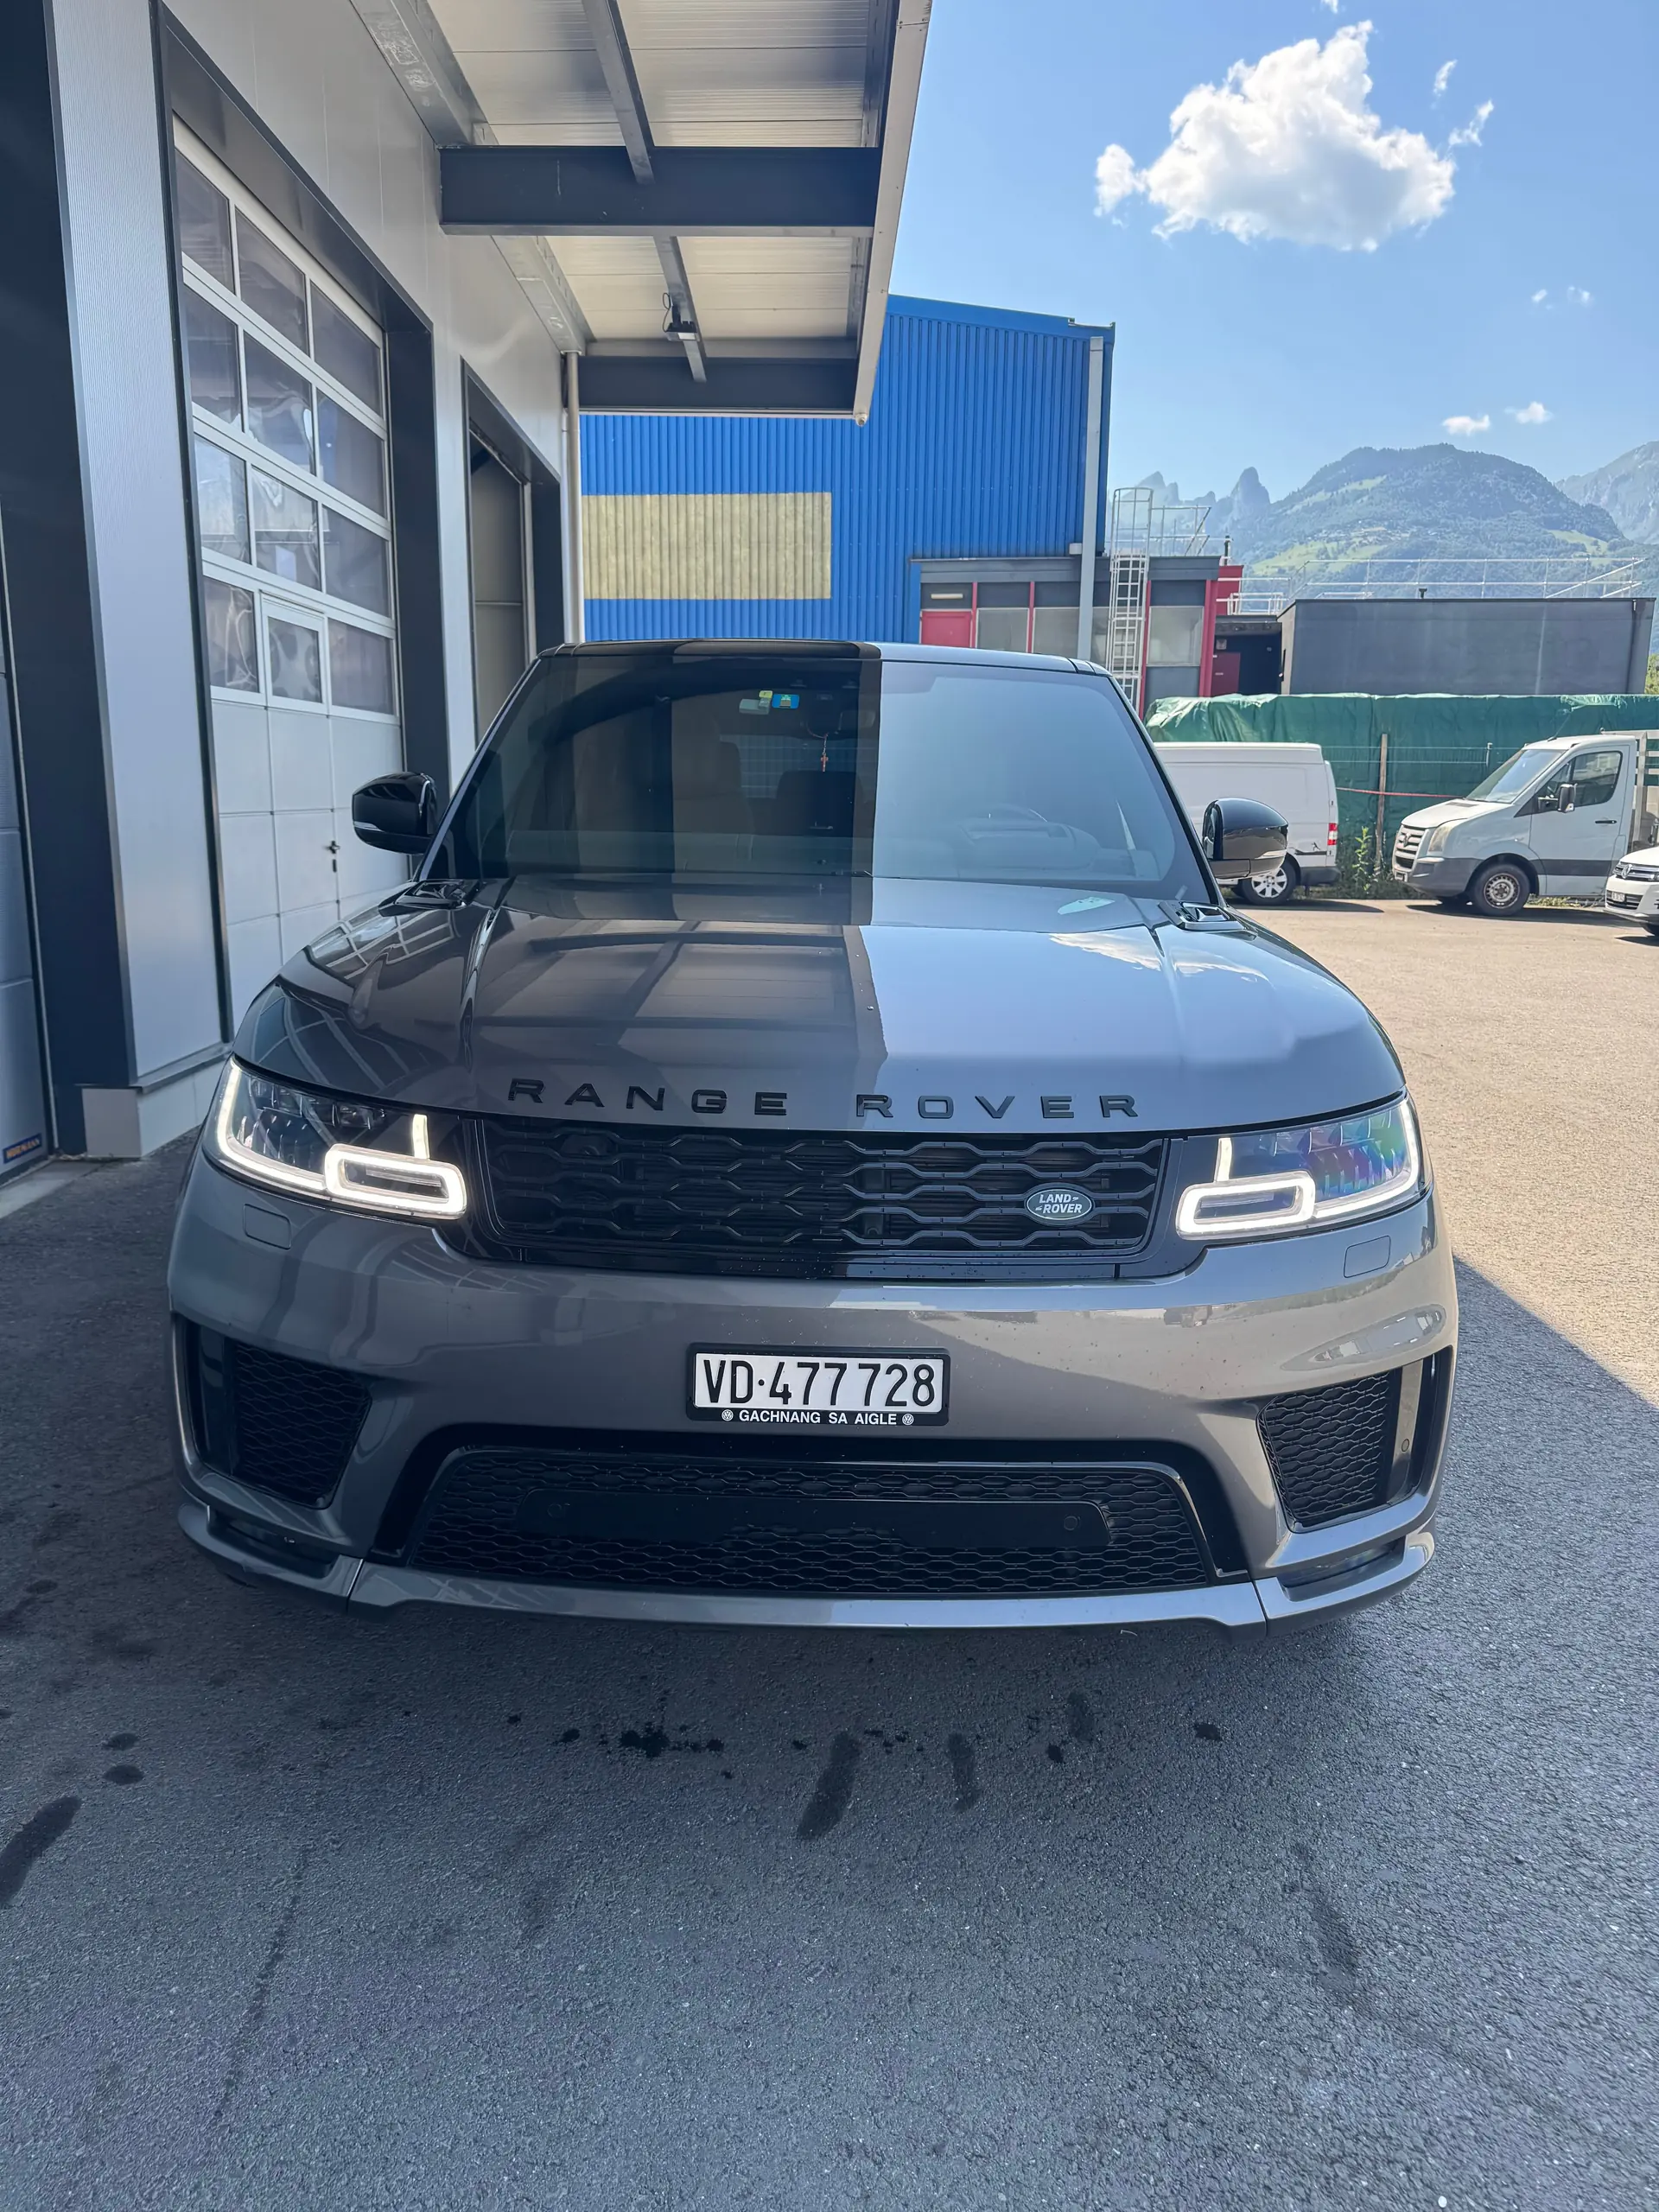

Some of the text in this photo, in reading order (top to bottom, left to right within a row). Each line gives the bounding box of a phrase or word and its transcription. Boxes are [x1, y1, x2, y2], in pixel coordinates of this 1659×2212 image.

[508, 1078, 1139, 1118] RANGE ROVER
[1039, 1193, 1071, 1204] LAND
[1042, 1204, 1083, 1214] ROVER
[739, 1409, 821, 1424] GACHNANG
[828, 1412, 848, 1425] SA
[854, 1413, 897, 1426] AIGLE
